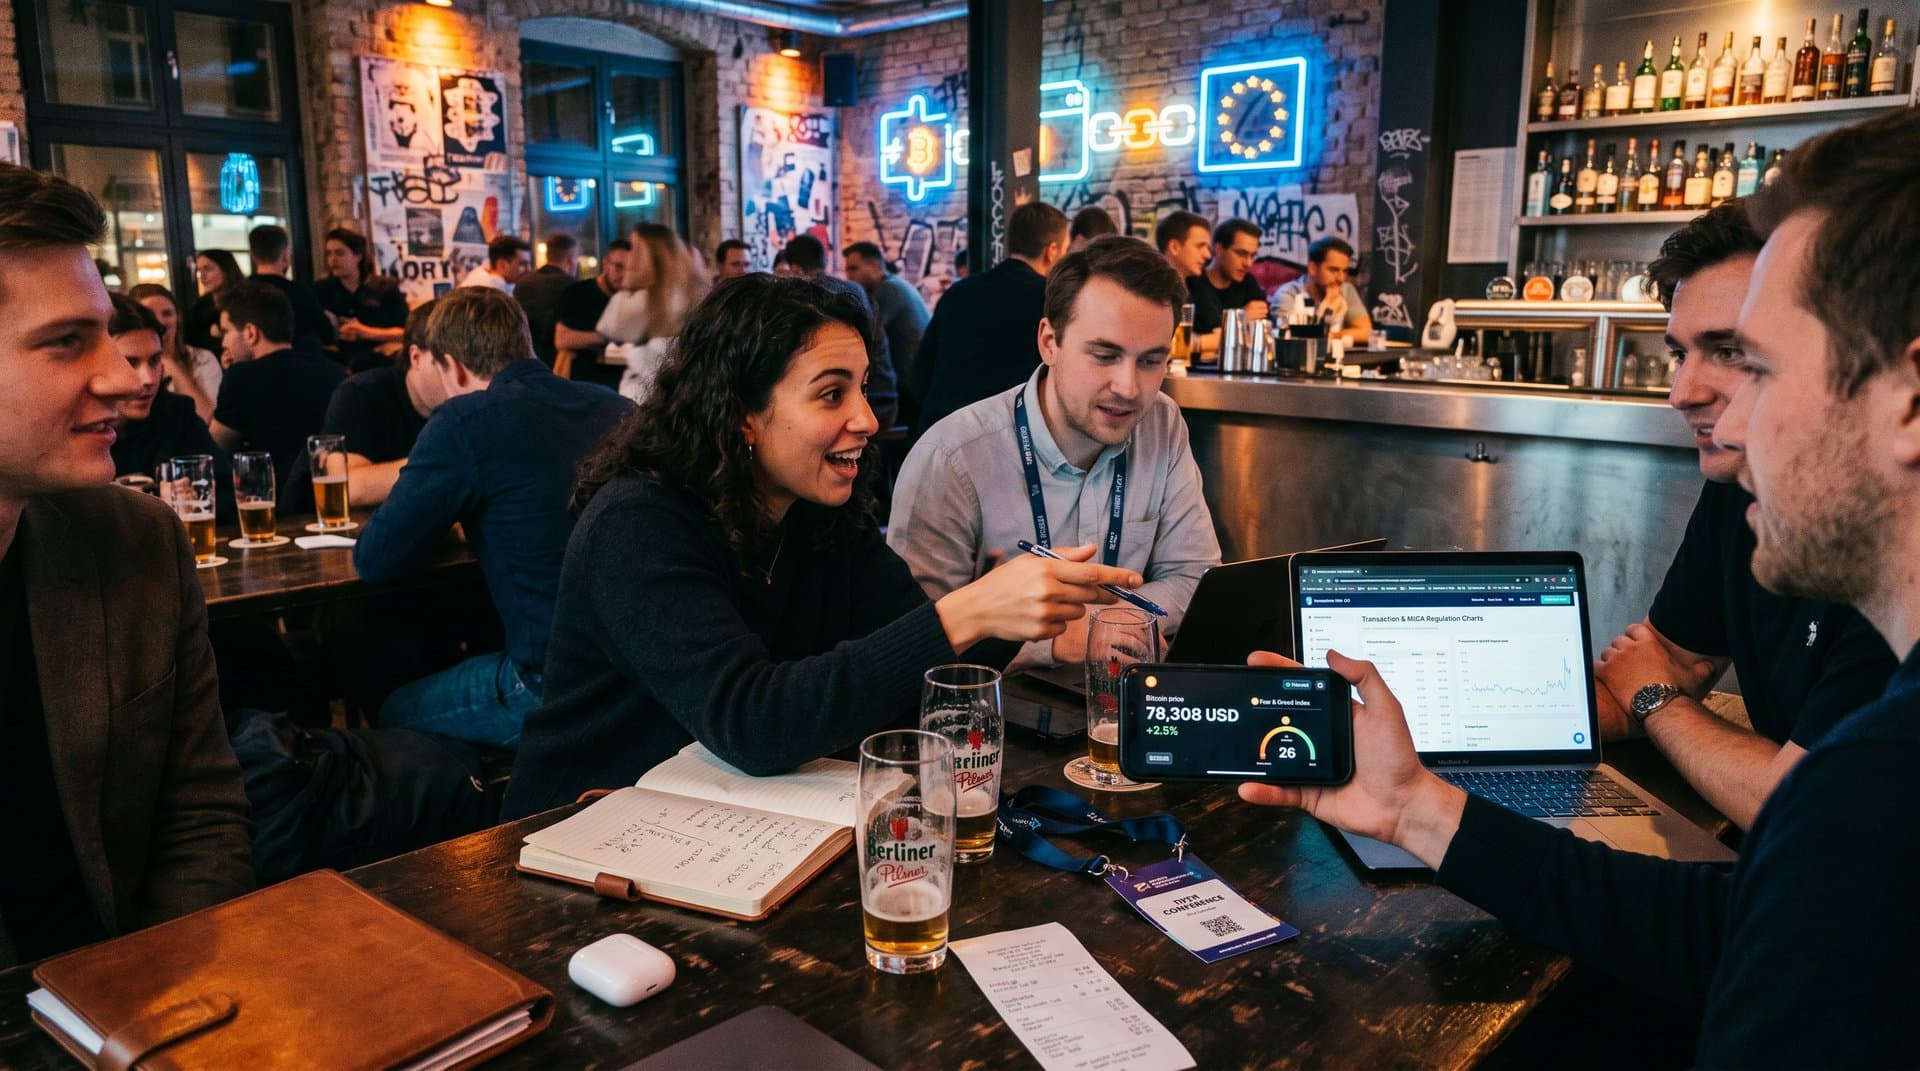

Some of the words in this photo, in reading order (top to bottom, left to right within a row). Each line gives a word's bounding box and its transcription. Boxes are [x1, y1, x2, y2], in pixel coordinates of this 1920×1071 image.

[1362, 615, 1399, 623] Transaction
[1426, 615, 1460, 624] Regulation
[1145, 694, 1167, 702] Bitcoin
[1168, 695, 1185, 704] price
[1145, 706, 1202, 722] 78,308
[1205, 707, 1239, 722] USD
[1146, 725, 1179, 736] +2.5%
[1278, 747, 1296, 759] 26
[868, 836, 936, 861] Berliner
[877, 863, 929, 885] Pilsner
[1163, 895, 1225, 916] CONFERENCE
